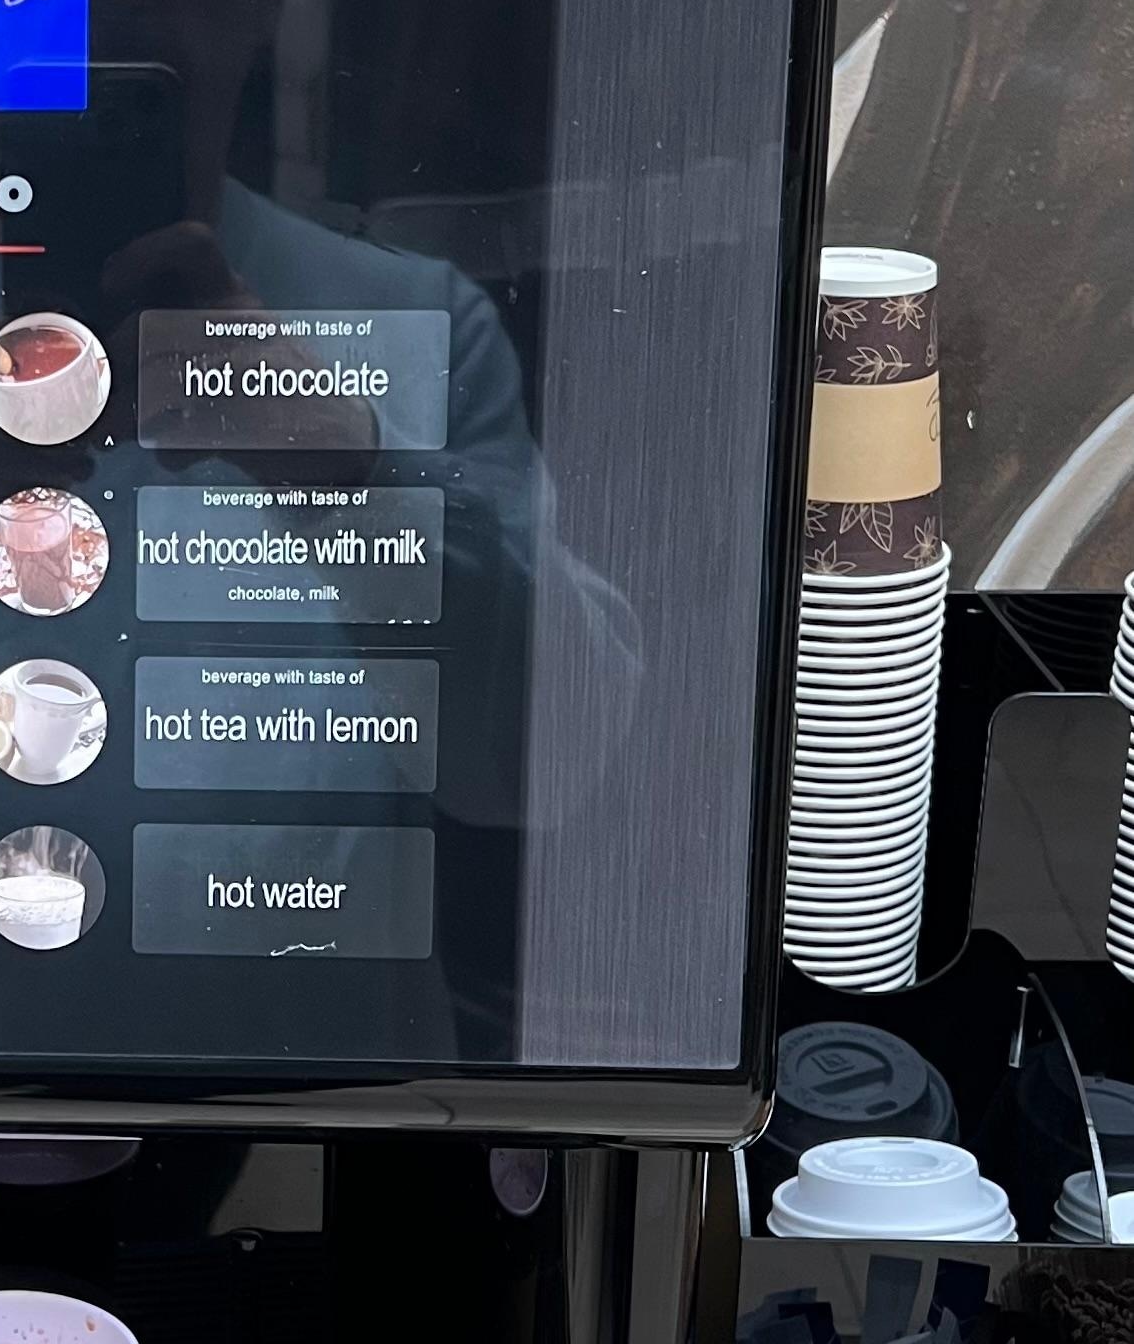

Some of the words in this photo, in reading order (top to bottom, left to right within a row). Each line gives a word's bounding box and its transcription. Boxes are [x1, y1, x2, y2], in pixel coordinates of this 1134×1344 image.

[205, 320, 277, 340] beverage
[279, 319, 311, 336] with
[315, 320, 353, 336] taste
[356, 319, 373, 336] of
[185, 360, 234, 397] hot
[241, 360, 390, 397] chocolate
[203, 490, 273, 509] beverage
[276, 489, 308, 506] with
[311, 490, 349, 506] taste
[351, 489, 369, 506] of
[138, 529, 180, 565] hot
[185, 529, 308, 565] chocolate
[313, 529, 367, 565] with
[373, 528, 426, 564] milk
[228, 585, 305, 602] chocolate,
[308, 585, 340, 601] milk
[201, 668, 271, 688] beverage
[274, 669, 305, 684] with
[308, 670, 346, 685] taste
[348, 669, 365, 685] of
[145, 706, 192, 741] hot
[200, 708, 247, 741] tea
[255, 707, 315, 742] with
[325, 708, 418, 743] lemon
[208, 873, 255, 908] hot
[262, 876, 347, 909] water
